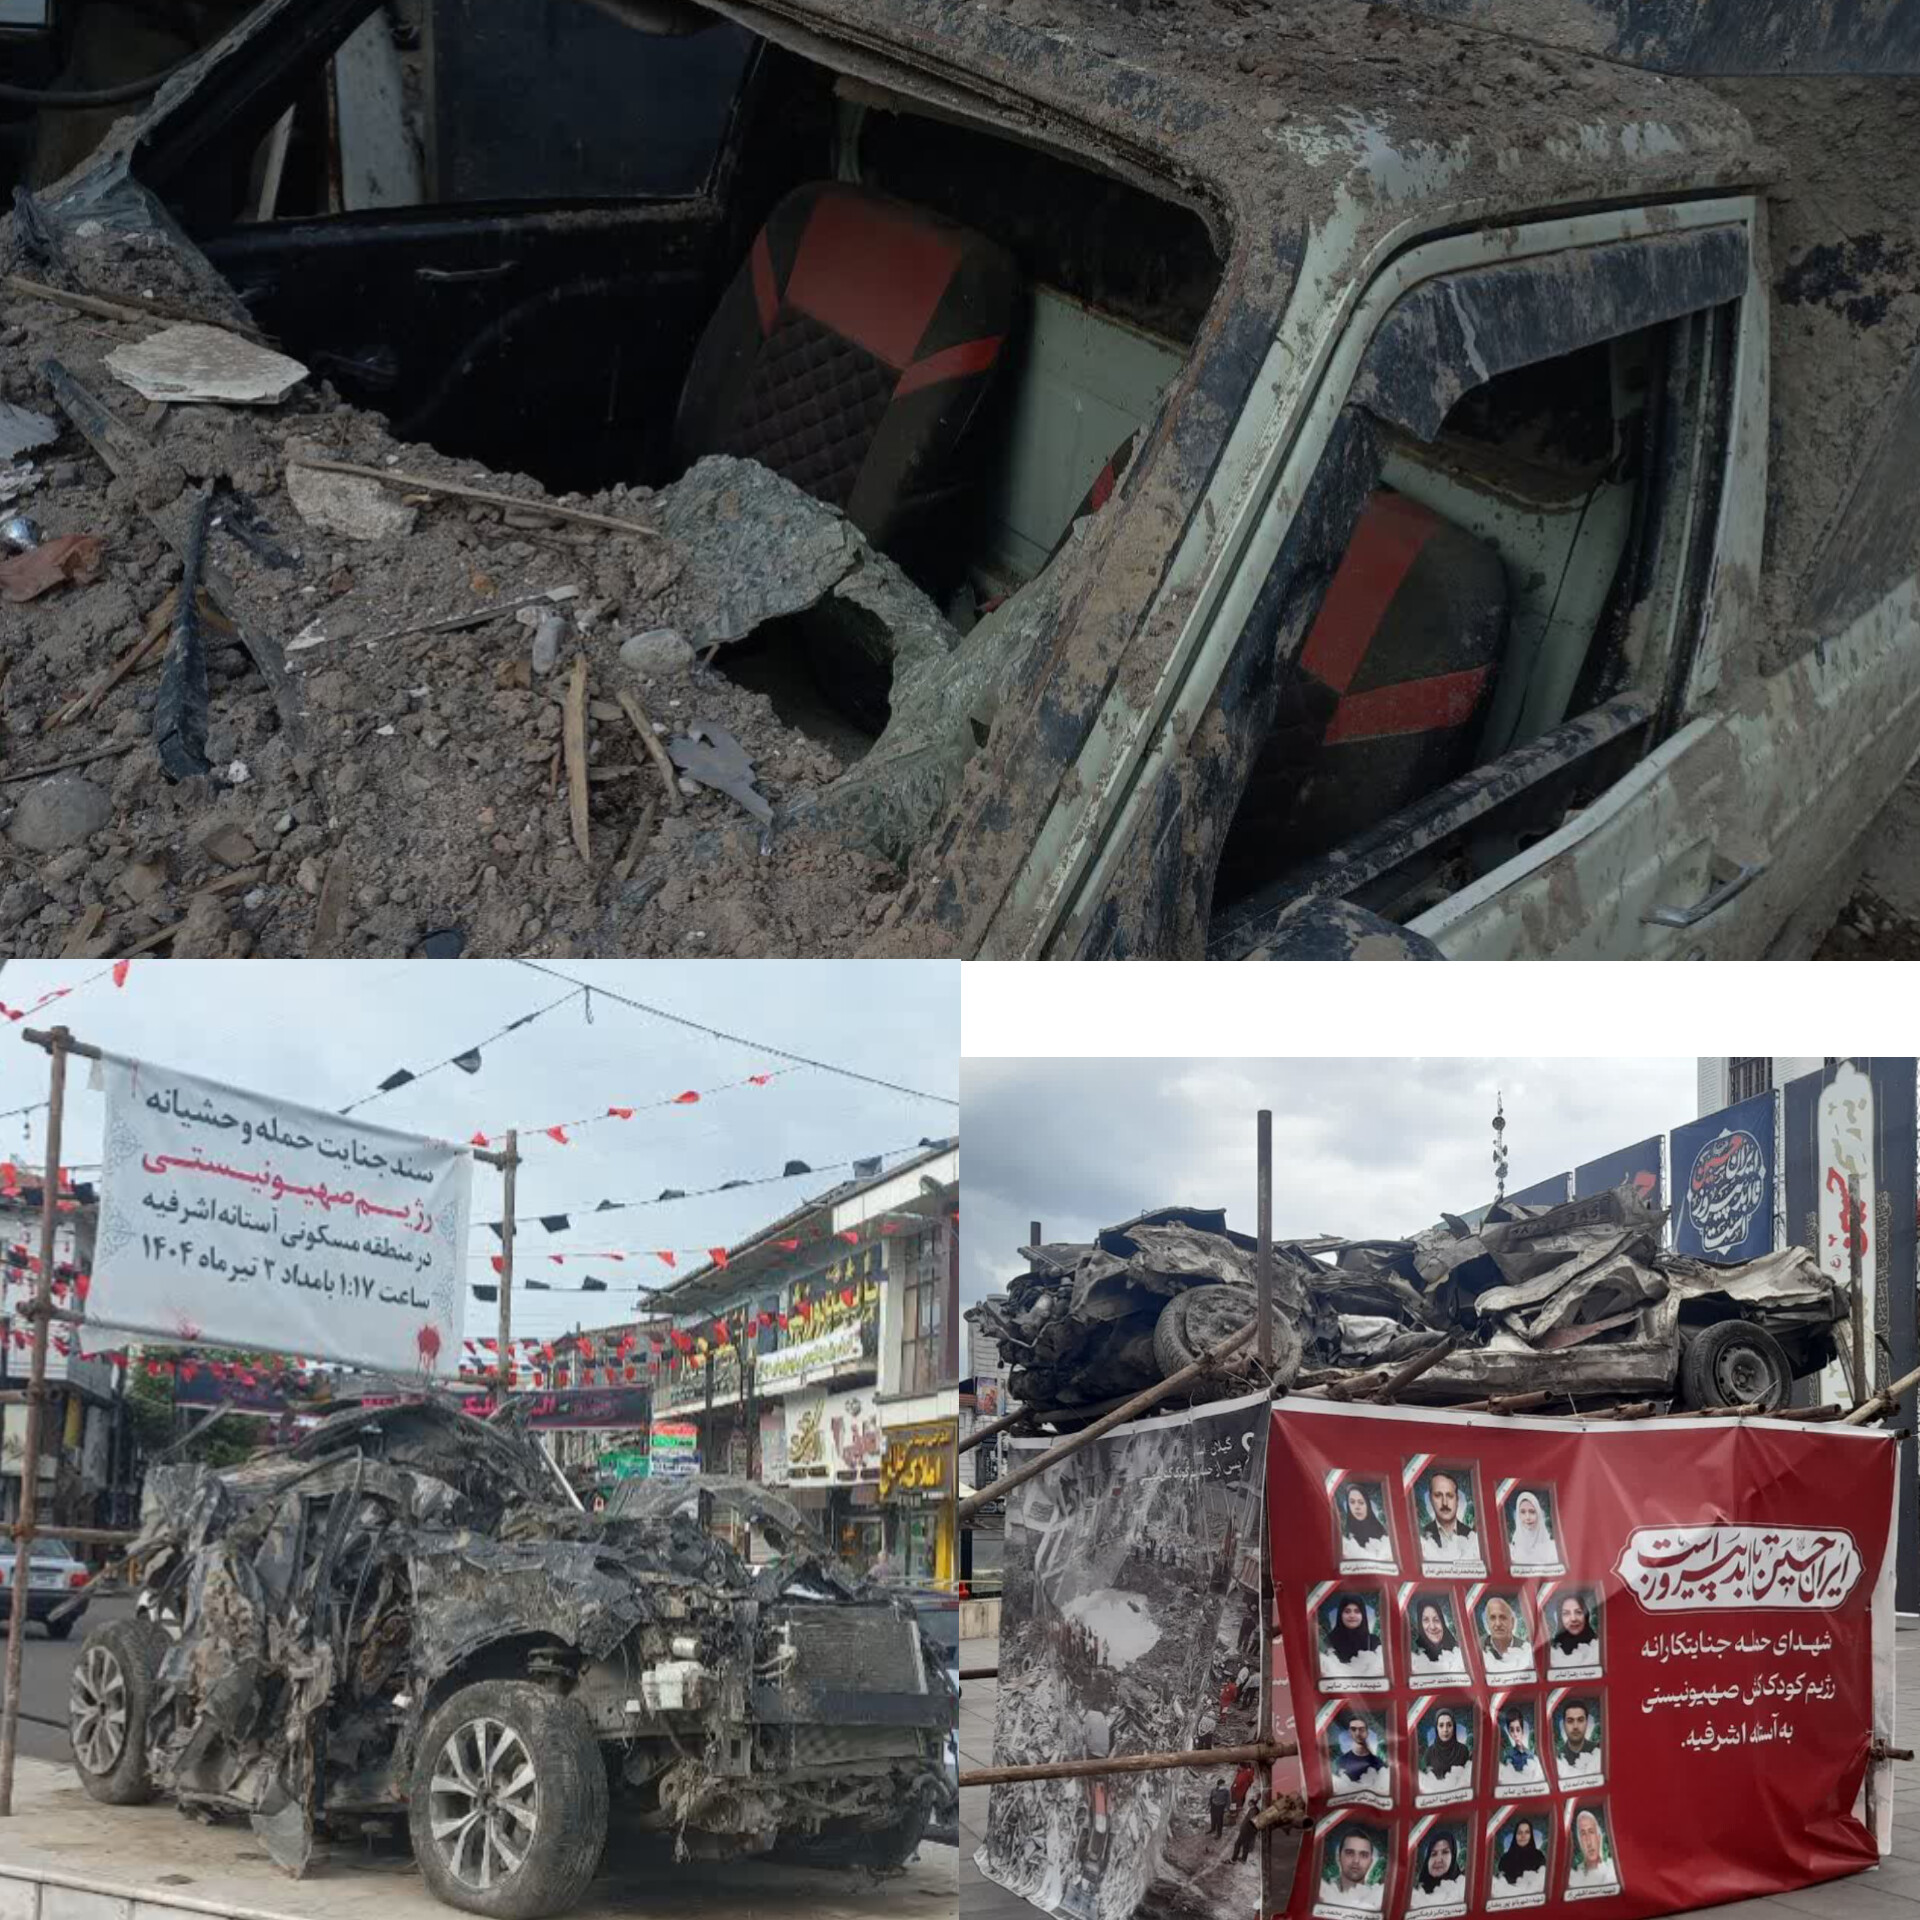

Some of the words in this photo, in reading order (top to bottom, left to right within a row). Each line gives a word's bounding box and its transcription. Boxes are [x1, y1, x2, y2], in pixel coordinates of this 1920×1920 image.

[255, 1116, 314, 1149] حمله
[317, 1139, 388, 1178] جنایت
[390, 1156, 434, 1183] سند
[142, 1147, 355, 1212] صهیونیستی
[142, 1189, 217, 1225] اشرفیه
[218, 1204, 278, 1233] آستانه
[355, 1197, 434, 1234] رژیم
[281, 1221, 361, 1251] مسکونی
[362, 1235, 415, 1263] منطقه
[415, 1251, 433, 1273] در
[281, 1263, 336, 1300] بامداد
[378, 1285, 431, 1310] ساعت
[1641, 1629, 1733, 1664] جنایتکارانه
[1772, 1629, 1833, 1657] شهدای
[1641, 1681, 1740, 1714] صهیونیستی
[1804, 1673, 1837, 1705] رژیم
[1778, 1721, 1795, 1745] به
